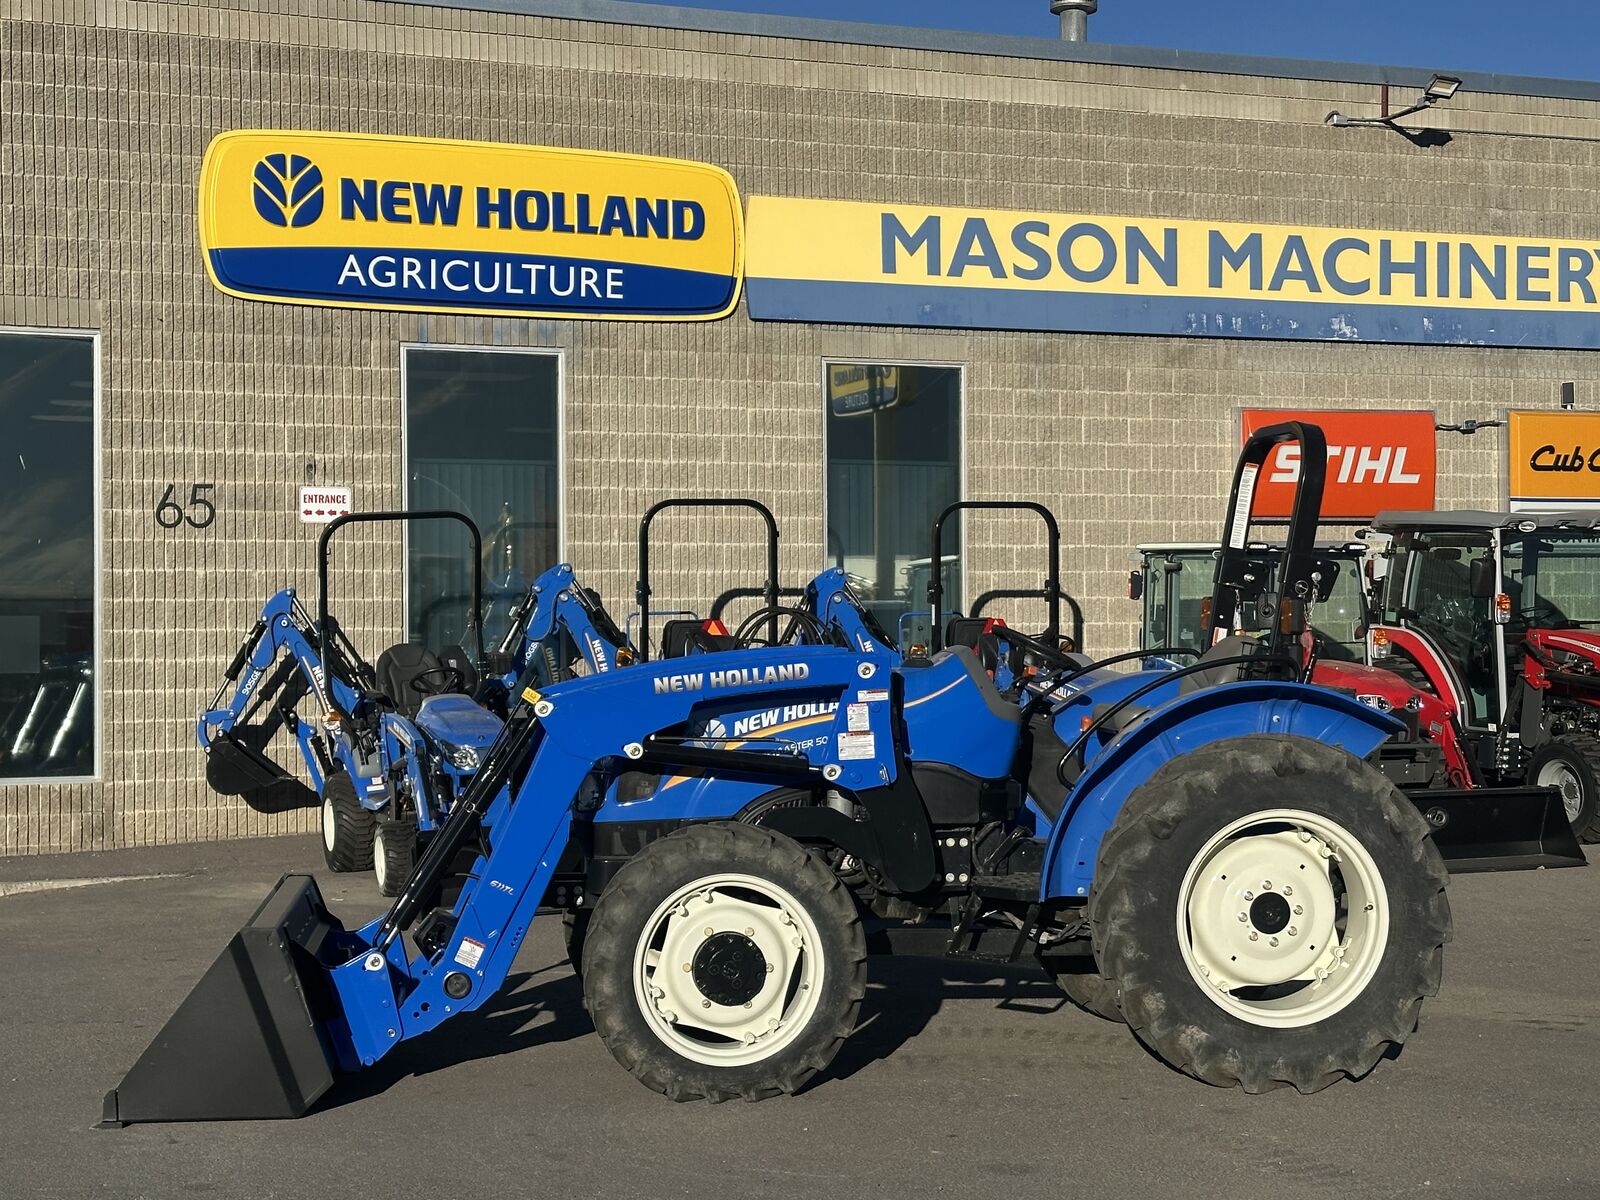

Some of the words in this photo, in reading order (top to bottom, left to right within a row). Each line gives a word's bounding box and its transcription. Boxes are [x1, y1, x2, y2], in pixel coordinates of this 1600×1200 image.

[339, 177, 463, 226] NEW
[474, 186, 706, 241] HOLLAND
[880, 212, 1178, 288] MASON
[1207, 228, 1600, 304] MACHINER
[337, 253, 624, 299] AGRICULTURE
[1269, 445, 1421, 485] STIHL
[1529, 444, 1585, 473] Cub
[155, 483, 216, 529] 65
[303, 494, 347, 504] ENTRANCE
[591, 639, 606, 665] NEW
[653, 672, 704, 695] NEW
[709, 662, 809, 689] HOLLAND
[734, 708, 781, 737] NEW
[815, 735, 829, 747] 50
